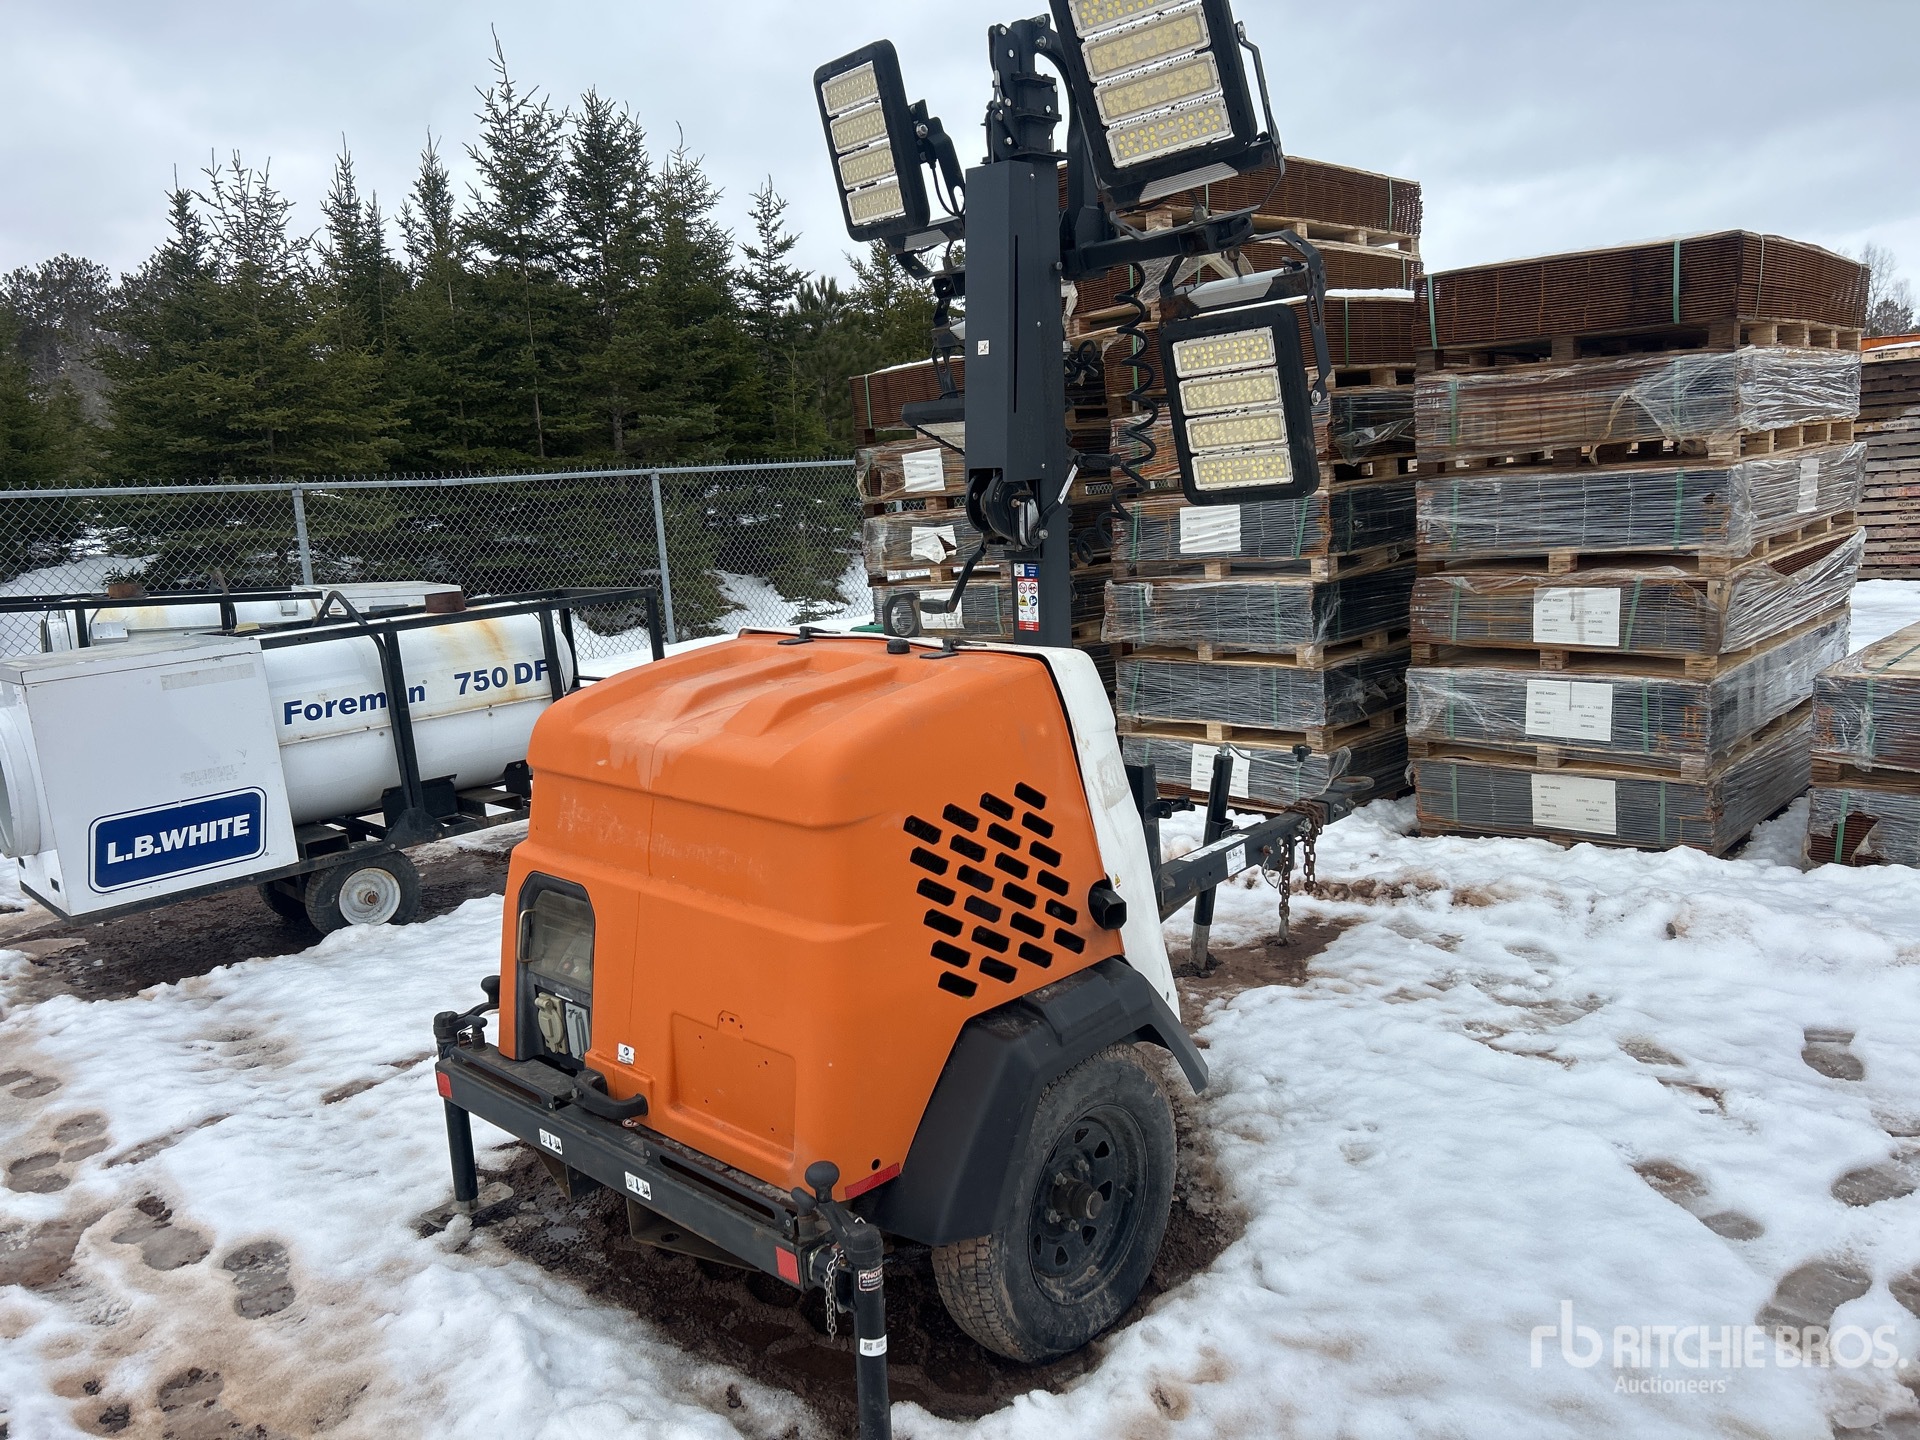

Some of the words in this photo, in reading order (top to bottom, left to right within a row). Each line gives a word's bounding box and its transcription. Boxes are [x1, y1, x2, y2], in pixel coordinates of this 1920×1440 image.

[284, 684, 426, 725] Foremn
[454, 666, 509, 696] 750
[514, 659, 549, 685] DF
[107, 813, 251, 865] L.B.WHITE
